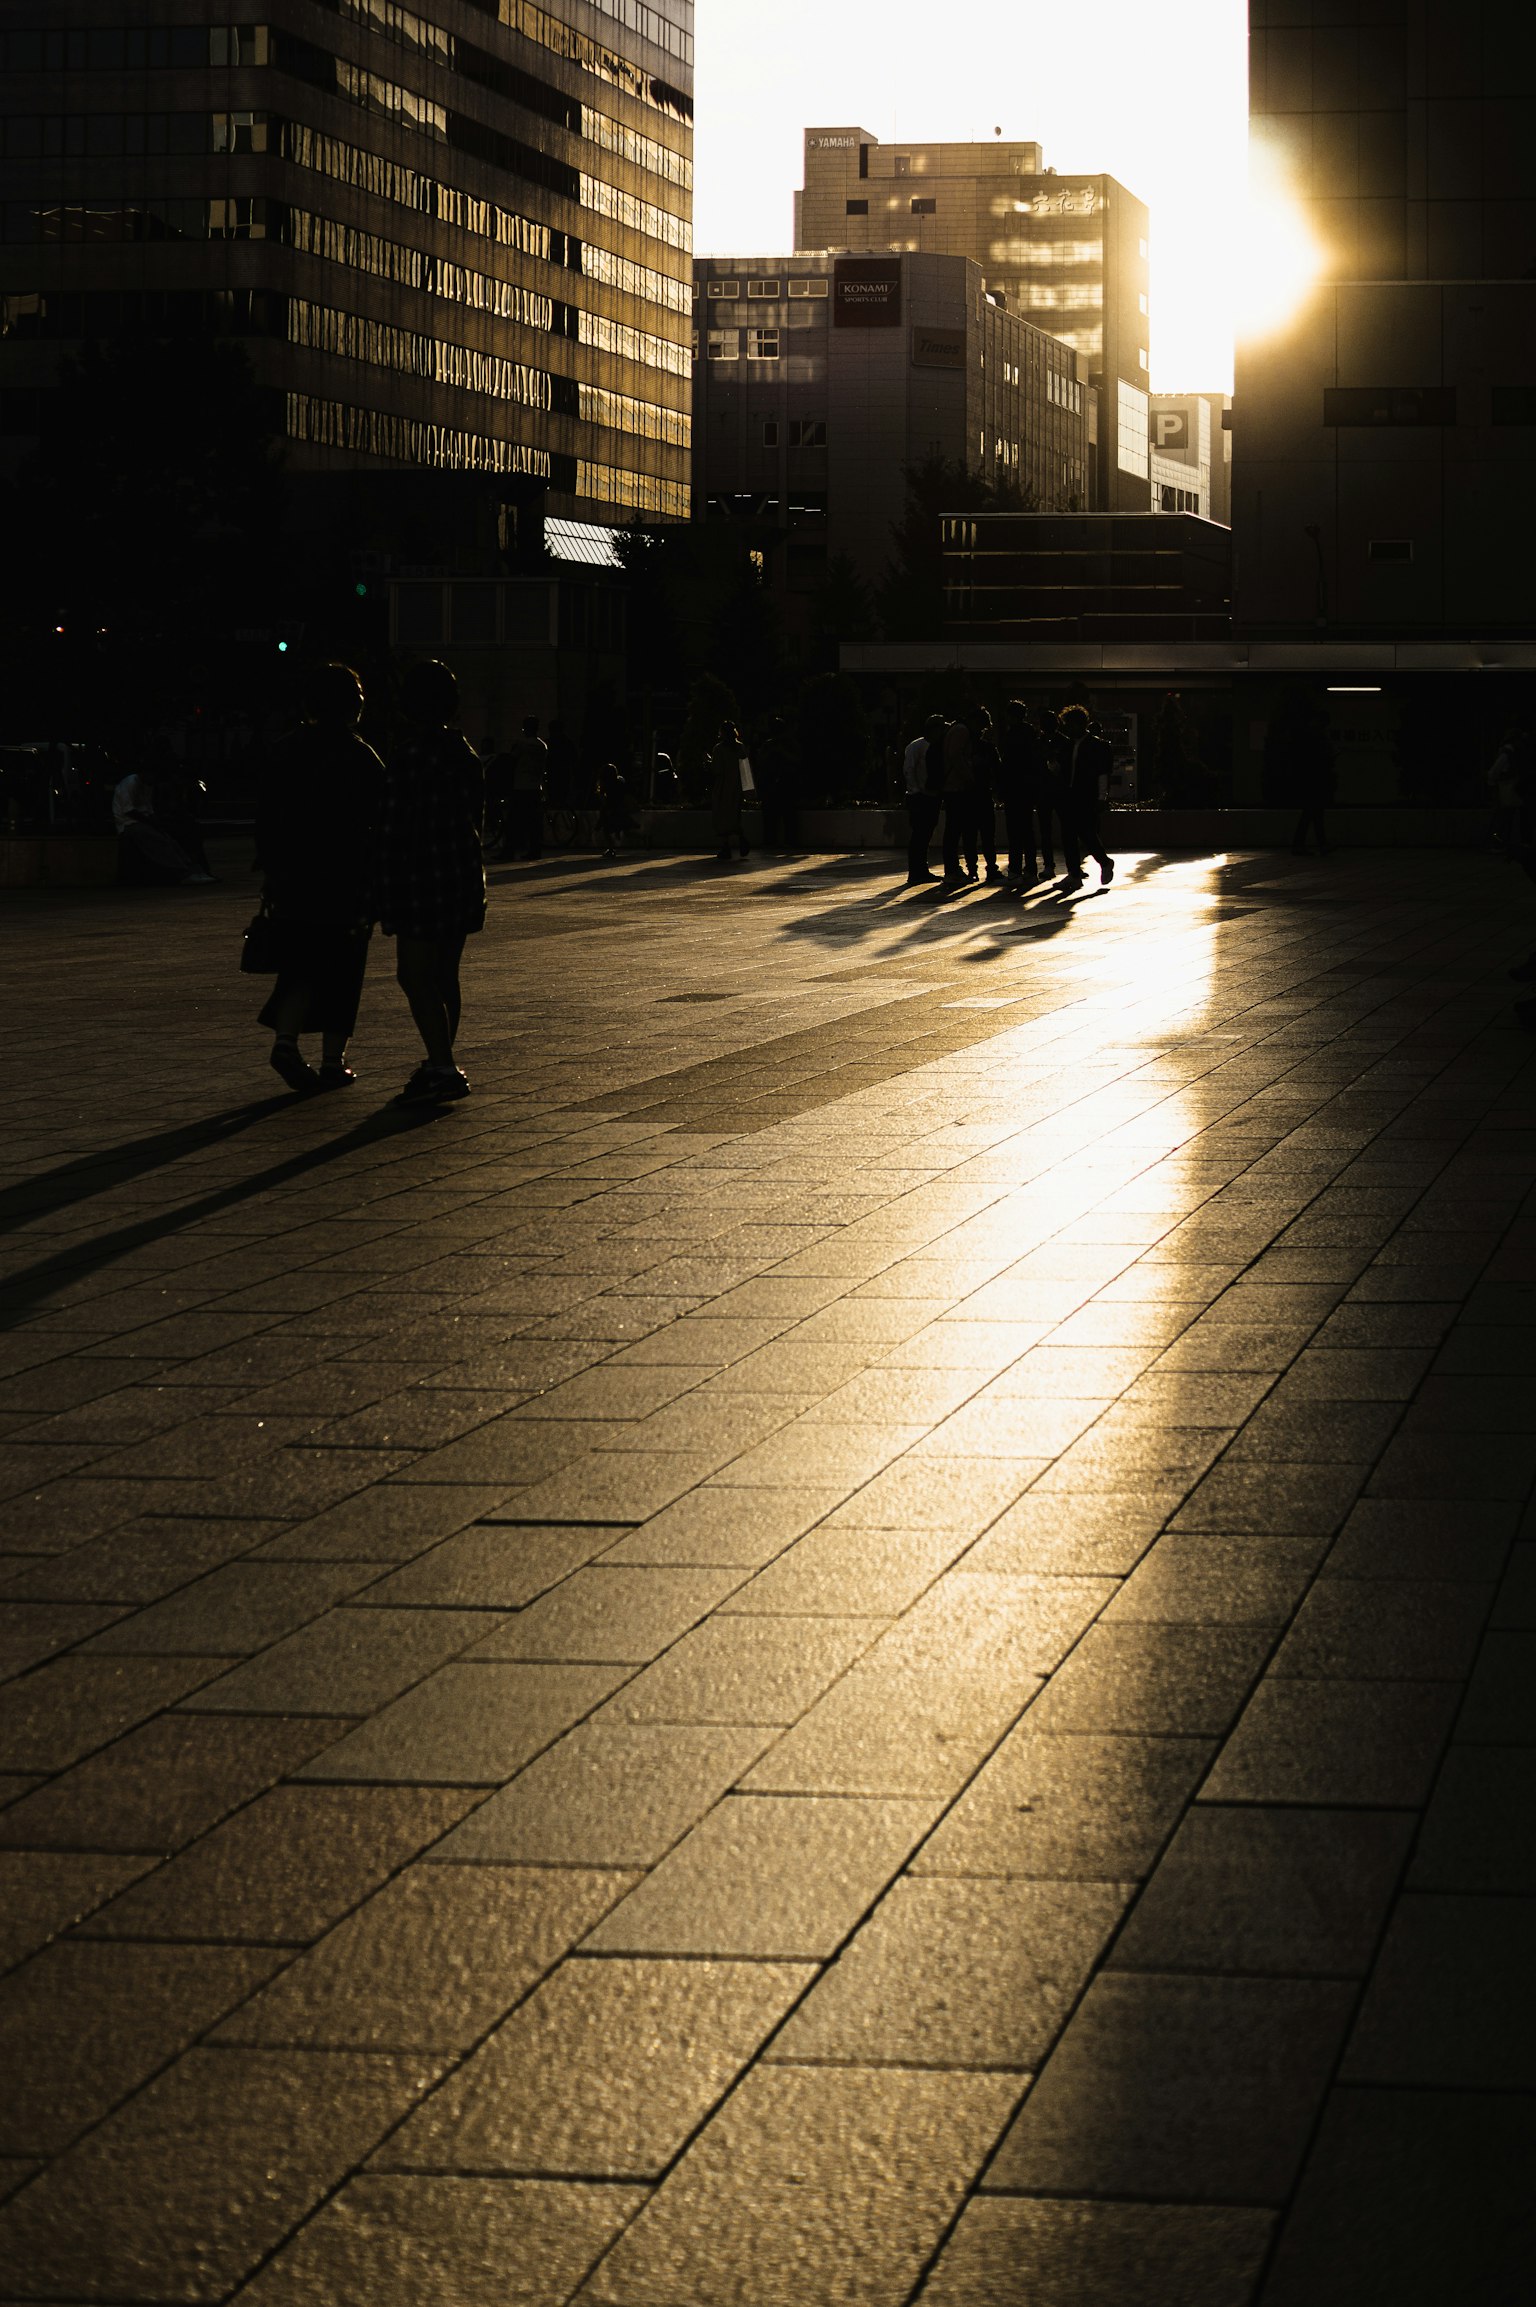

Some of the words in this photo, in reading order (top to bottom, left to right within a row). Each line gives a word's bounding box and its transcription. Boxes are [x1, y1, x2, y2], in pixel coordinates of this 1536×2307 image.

[818, 137, 855, 148] YAMAHA
[1032, 184, 1096, 216] 六花亭
[844, 284, 888, 293] KONAMI
[920, 339, 961, 354] Times
[1157, 414, 1183, 445] P
